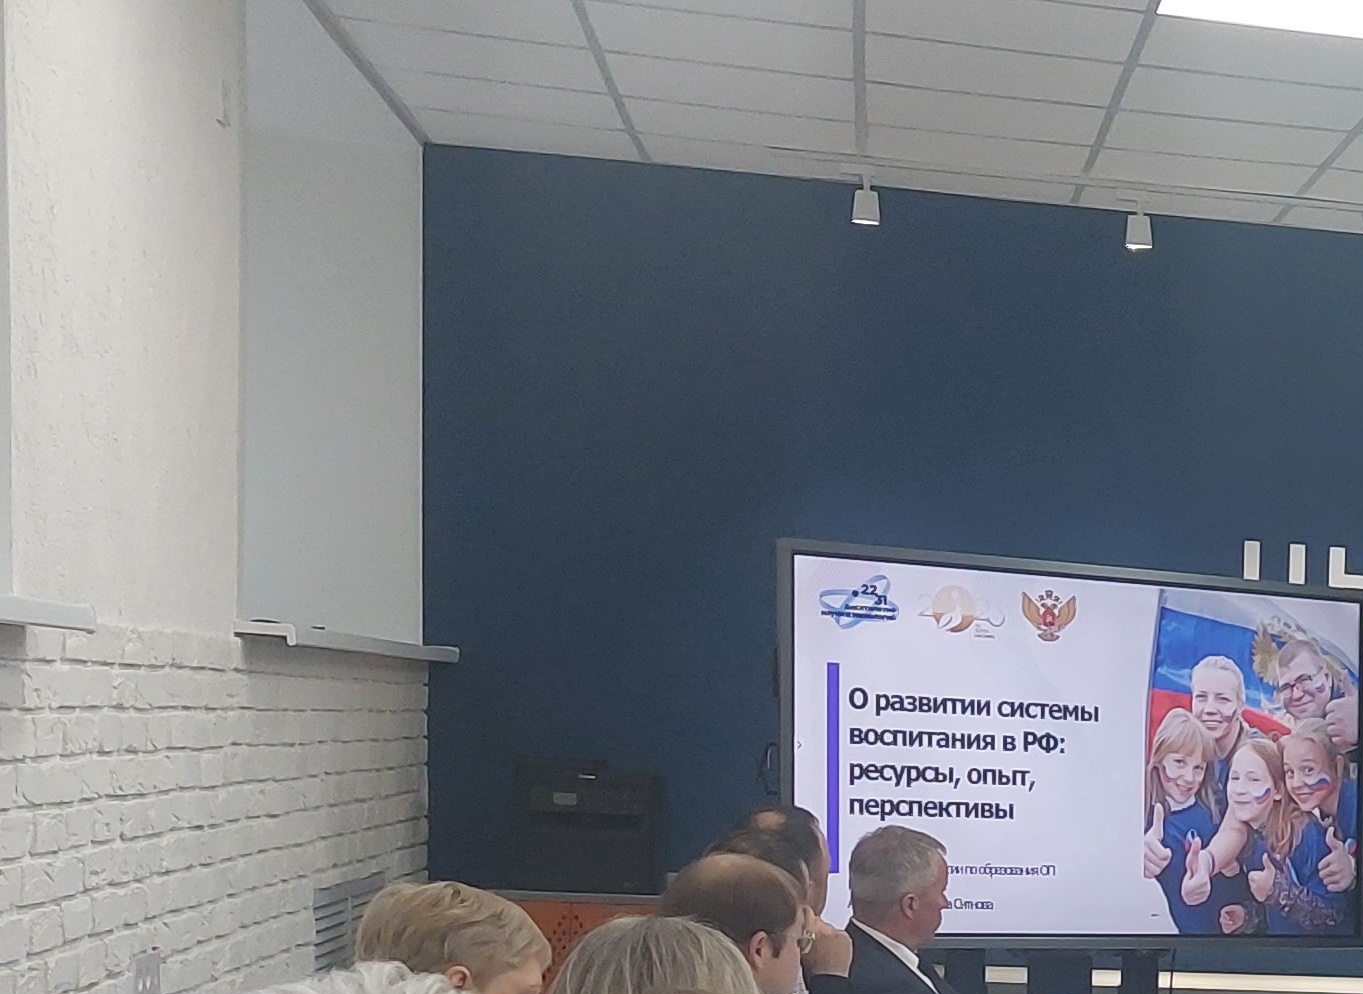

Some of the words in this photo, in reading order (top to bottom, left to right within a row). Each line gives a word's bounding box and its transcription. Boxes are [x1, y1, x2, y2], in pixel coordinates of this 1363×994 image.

[860, 584, 878, 595] 22
[849, 687, 869, 710] О
[875, 693, 991, 716] развитии
[997, 700, 1100, 723] системы
[849, 727, 996, 751] воспитания
[1002, 735, 1017, 752] в
[1023, 731, 1066, 754] РФ:
[849, 762, 961, 790] ресурсы,
[966, 767, 1036, 792] опыт,
[849, 797, 1015, 821] перспективы
